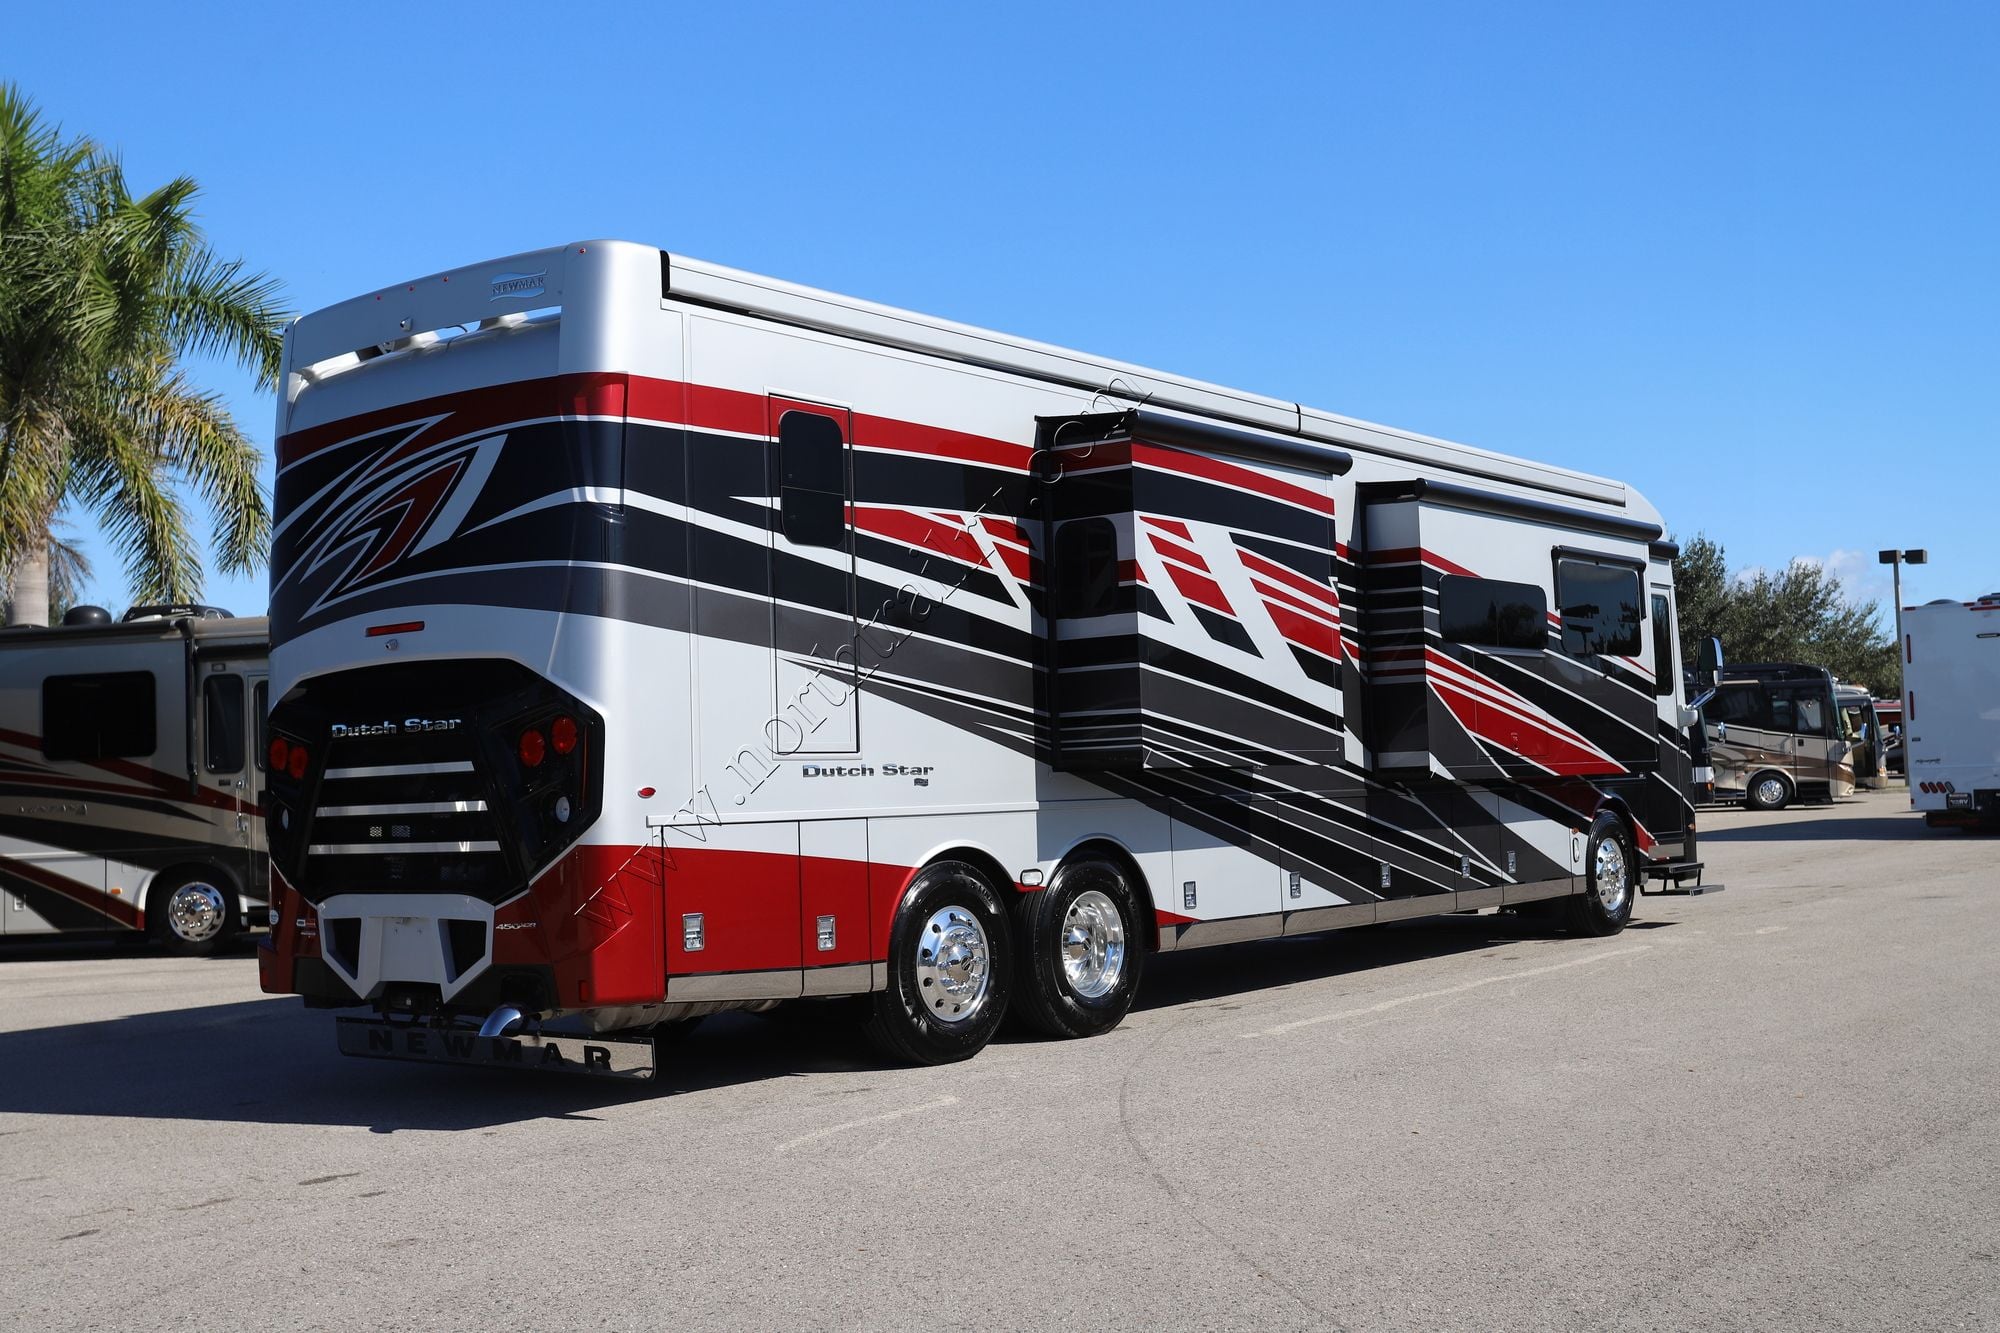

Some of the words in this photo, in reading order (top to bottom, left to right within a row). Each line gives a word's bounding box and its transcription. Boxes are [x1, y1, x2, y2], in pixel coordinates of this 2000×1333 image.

[491, 276, 544, 296] NEWMAR
[331, 720, 397, 738] Dutch
[404, 718, 462, 733] Star
[802, 763, 875, 778] Dutch
[881, 763, 934, 776] Star
[368, 1028, 612, 1071] NEWMAR
